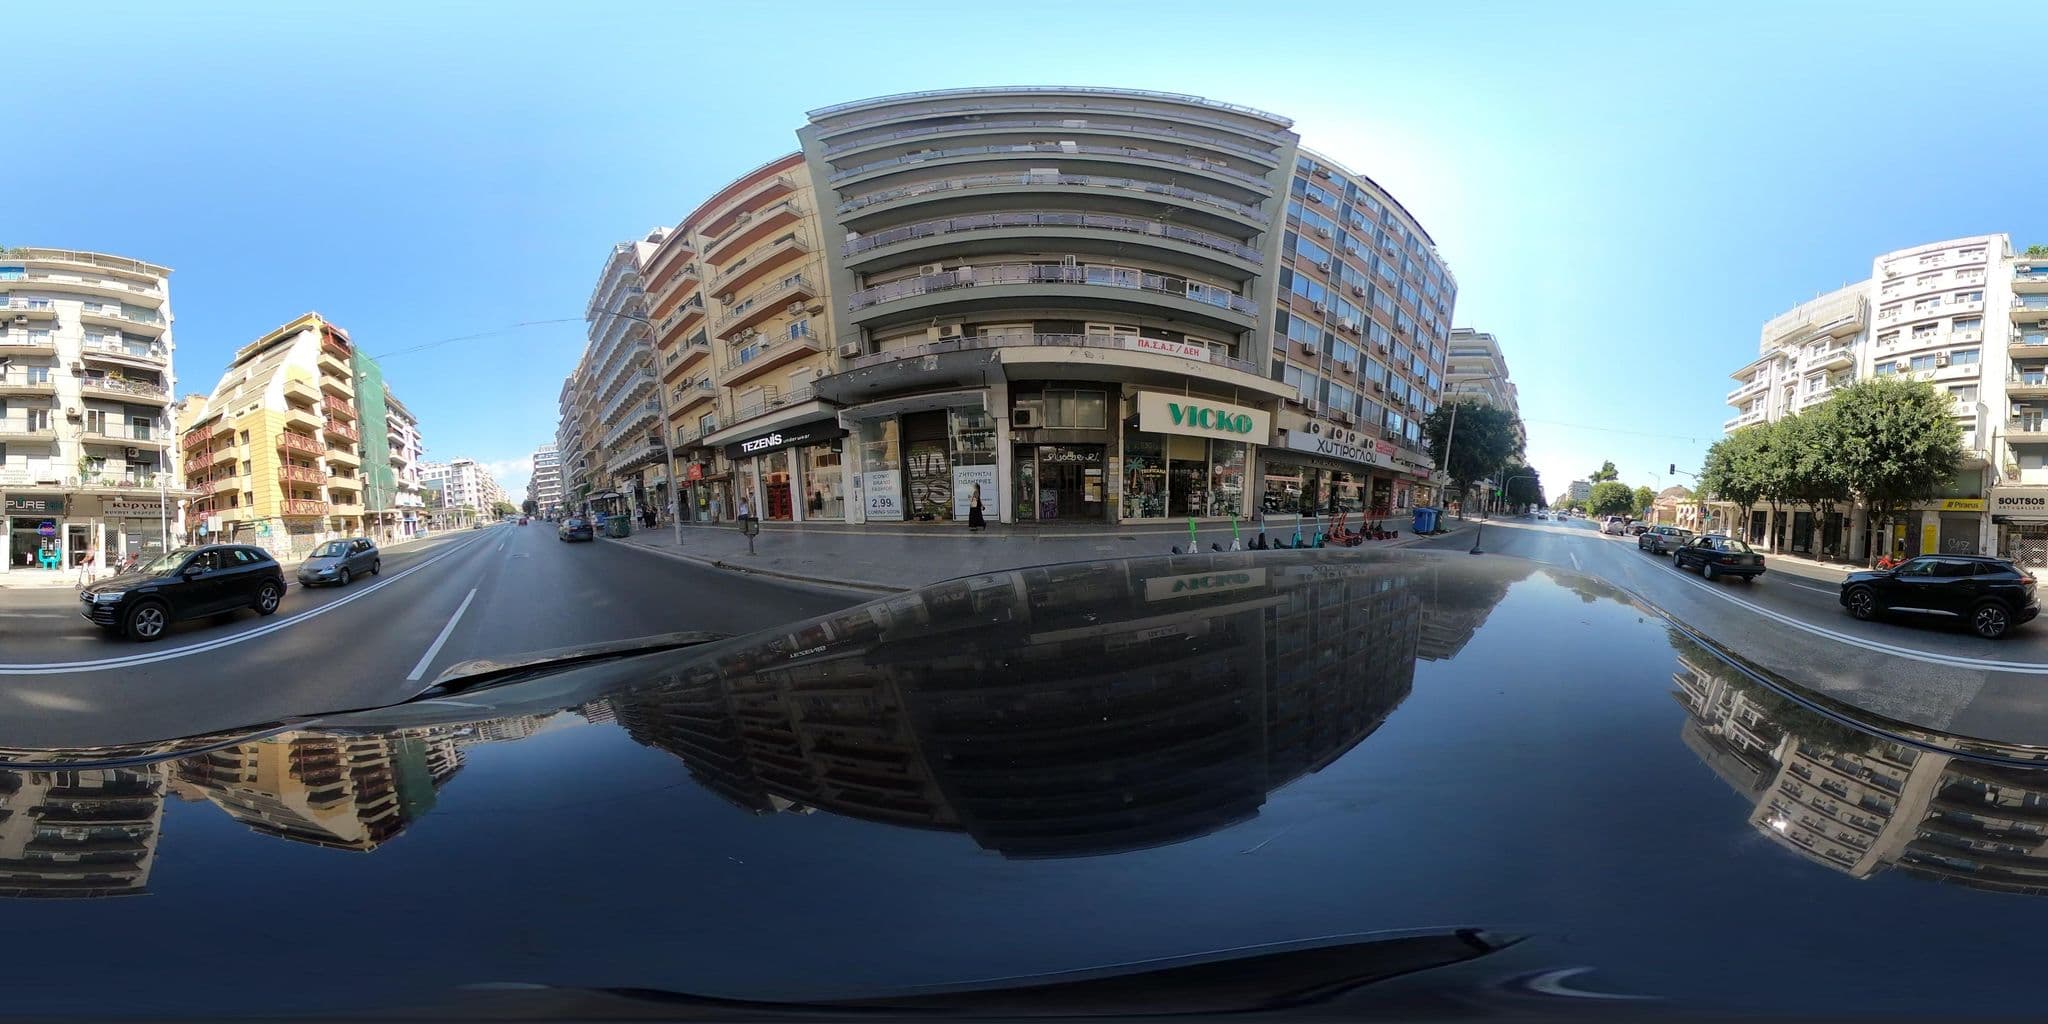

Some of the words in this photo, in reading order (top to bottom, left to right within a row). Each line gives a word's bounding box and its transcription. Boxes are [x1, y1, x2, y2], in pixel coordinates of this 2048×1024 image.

[1184, 346, 1200, 357] ΔΕΗ
[1168, 403, 1253, 434] VICKO
[5, 500, 46, 509] PURE
[1998, 497, 2045, 505] SOUTSOS
